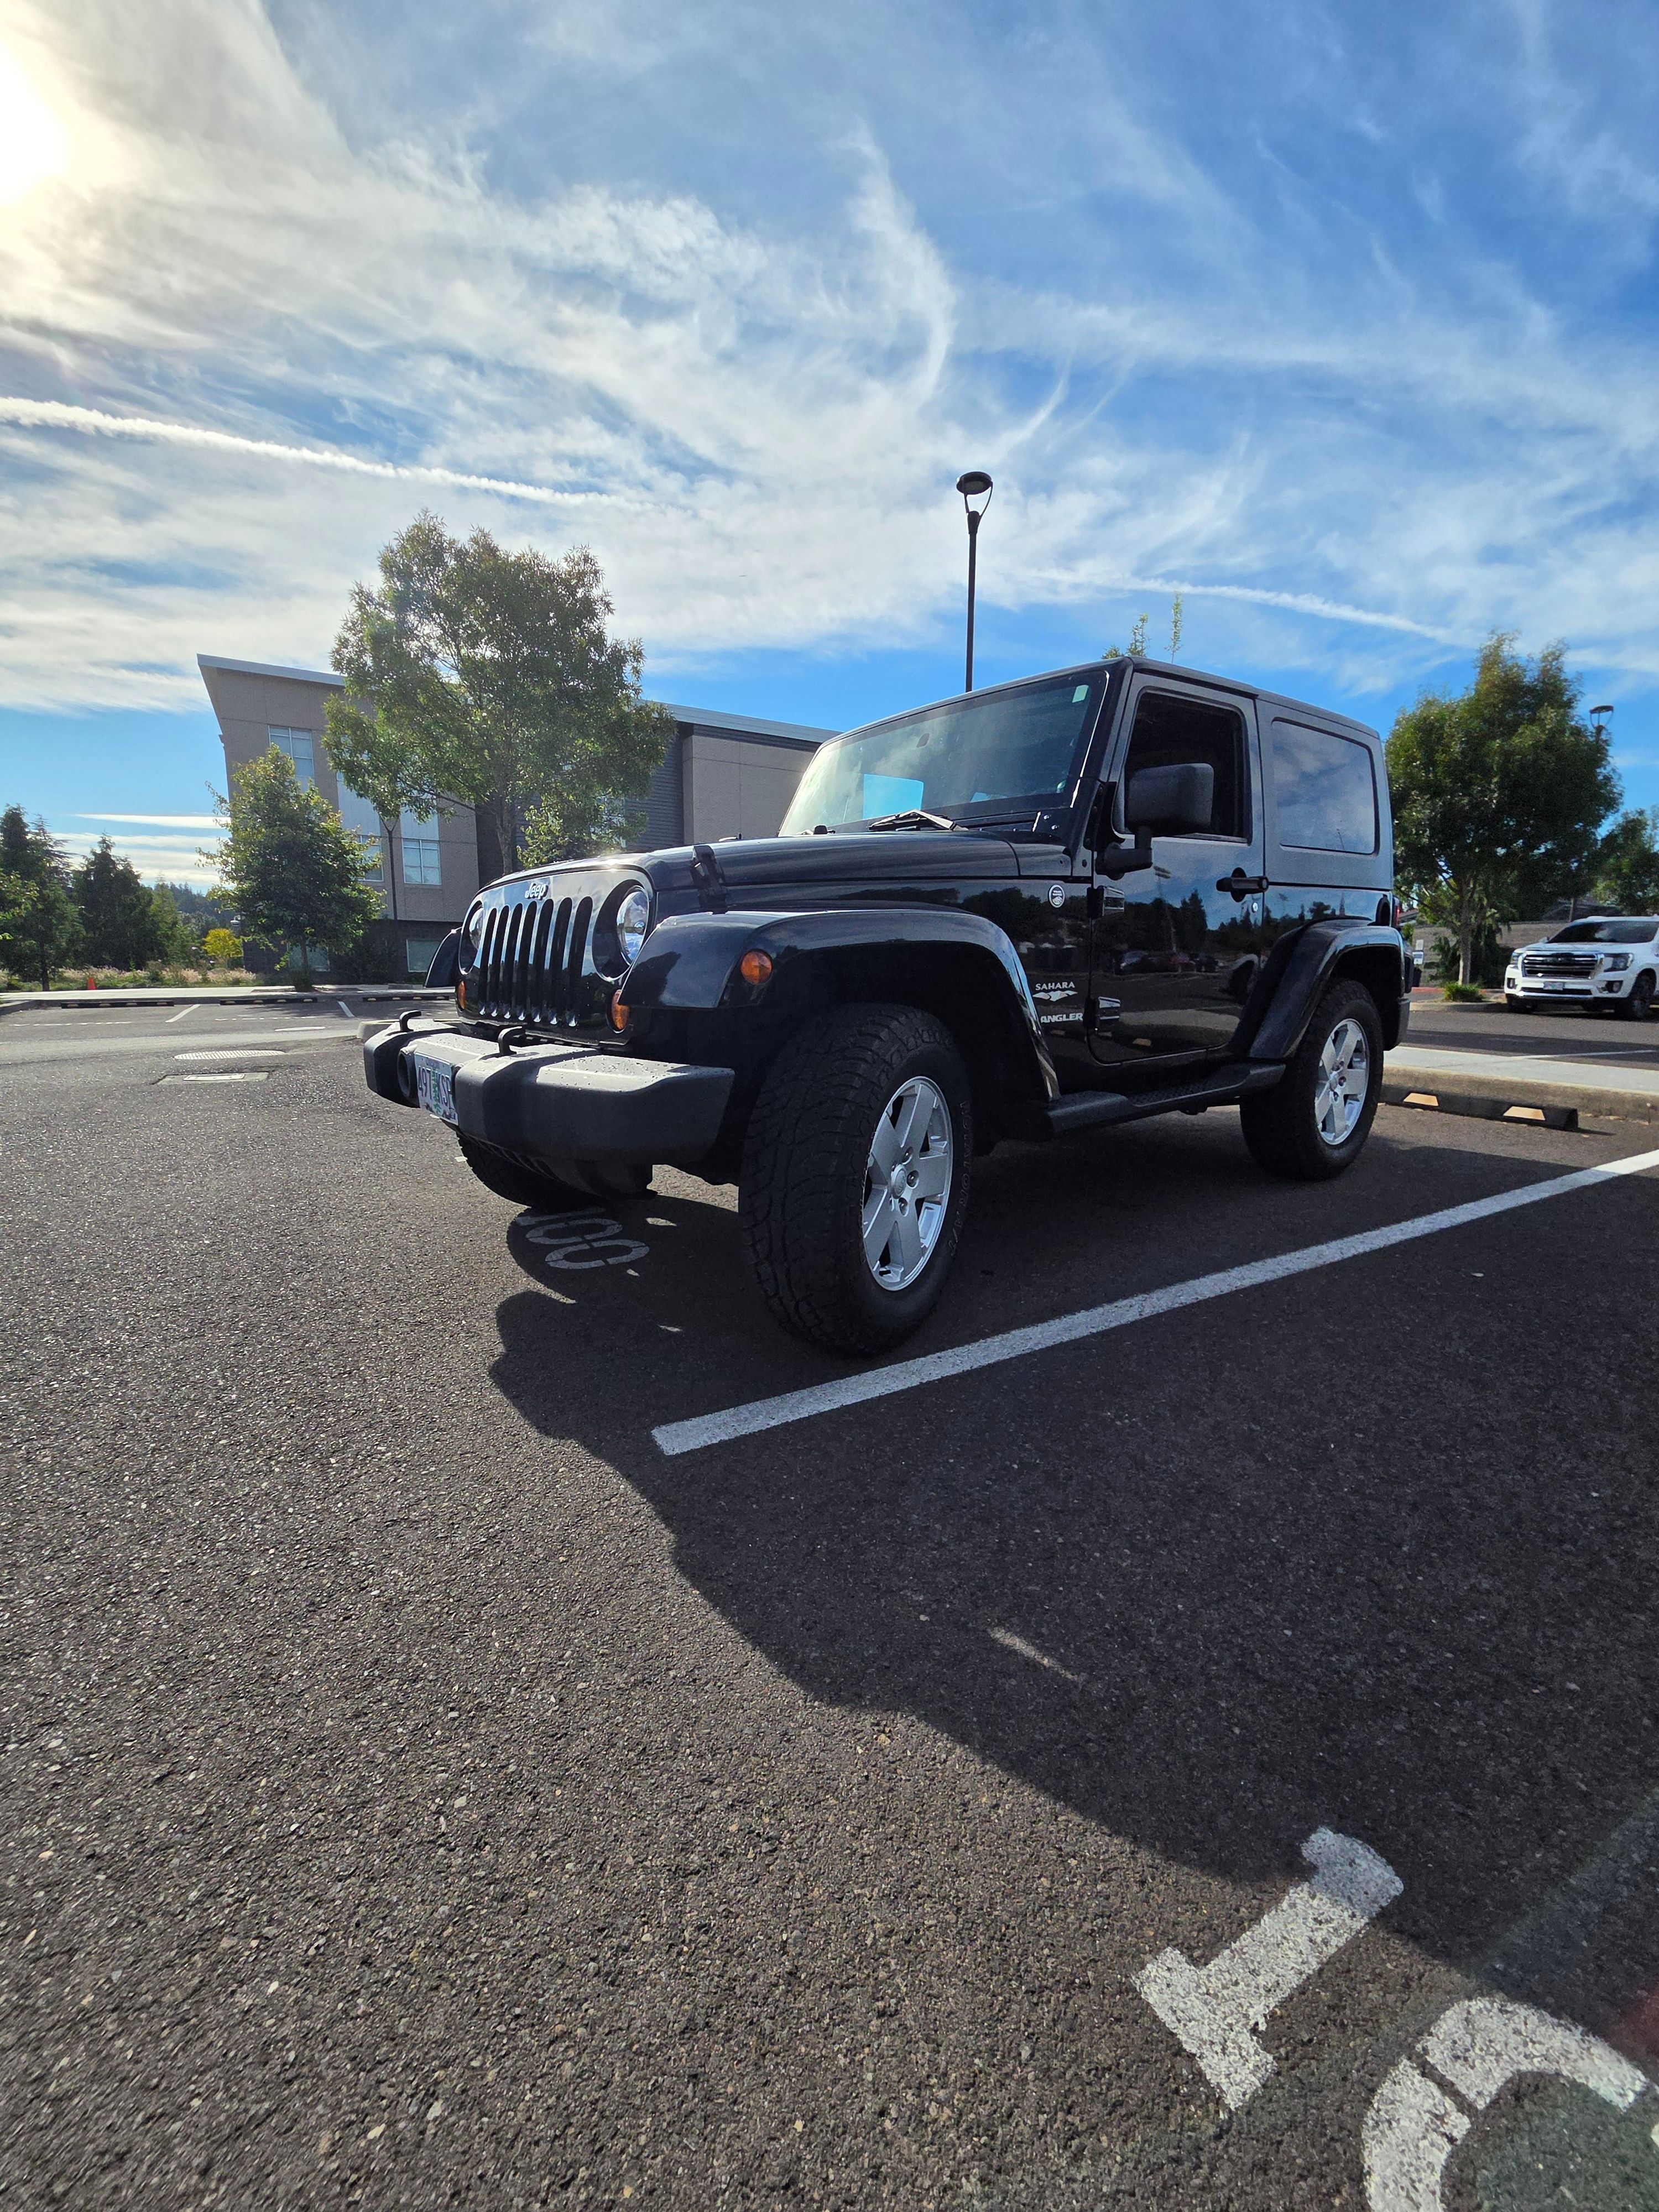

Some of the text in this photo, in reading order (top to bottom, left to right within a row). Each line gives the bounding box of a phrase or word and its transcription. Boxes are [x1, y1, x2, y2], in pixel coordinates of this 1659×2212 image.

[524, 882, 547, 900] Jeep
[1035, 982, 1075, 991] SAHARA
[1040, 1013, 1083, 1023] ANGLER
[514, 1207, 650, 1270] 100
